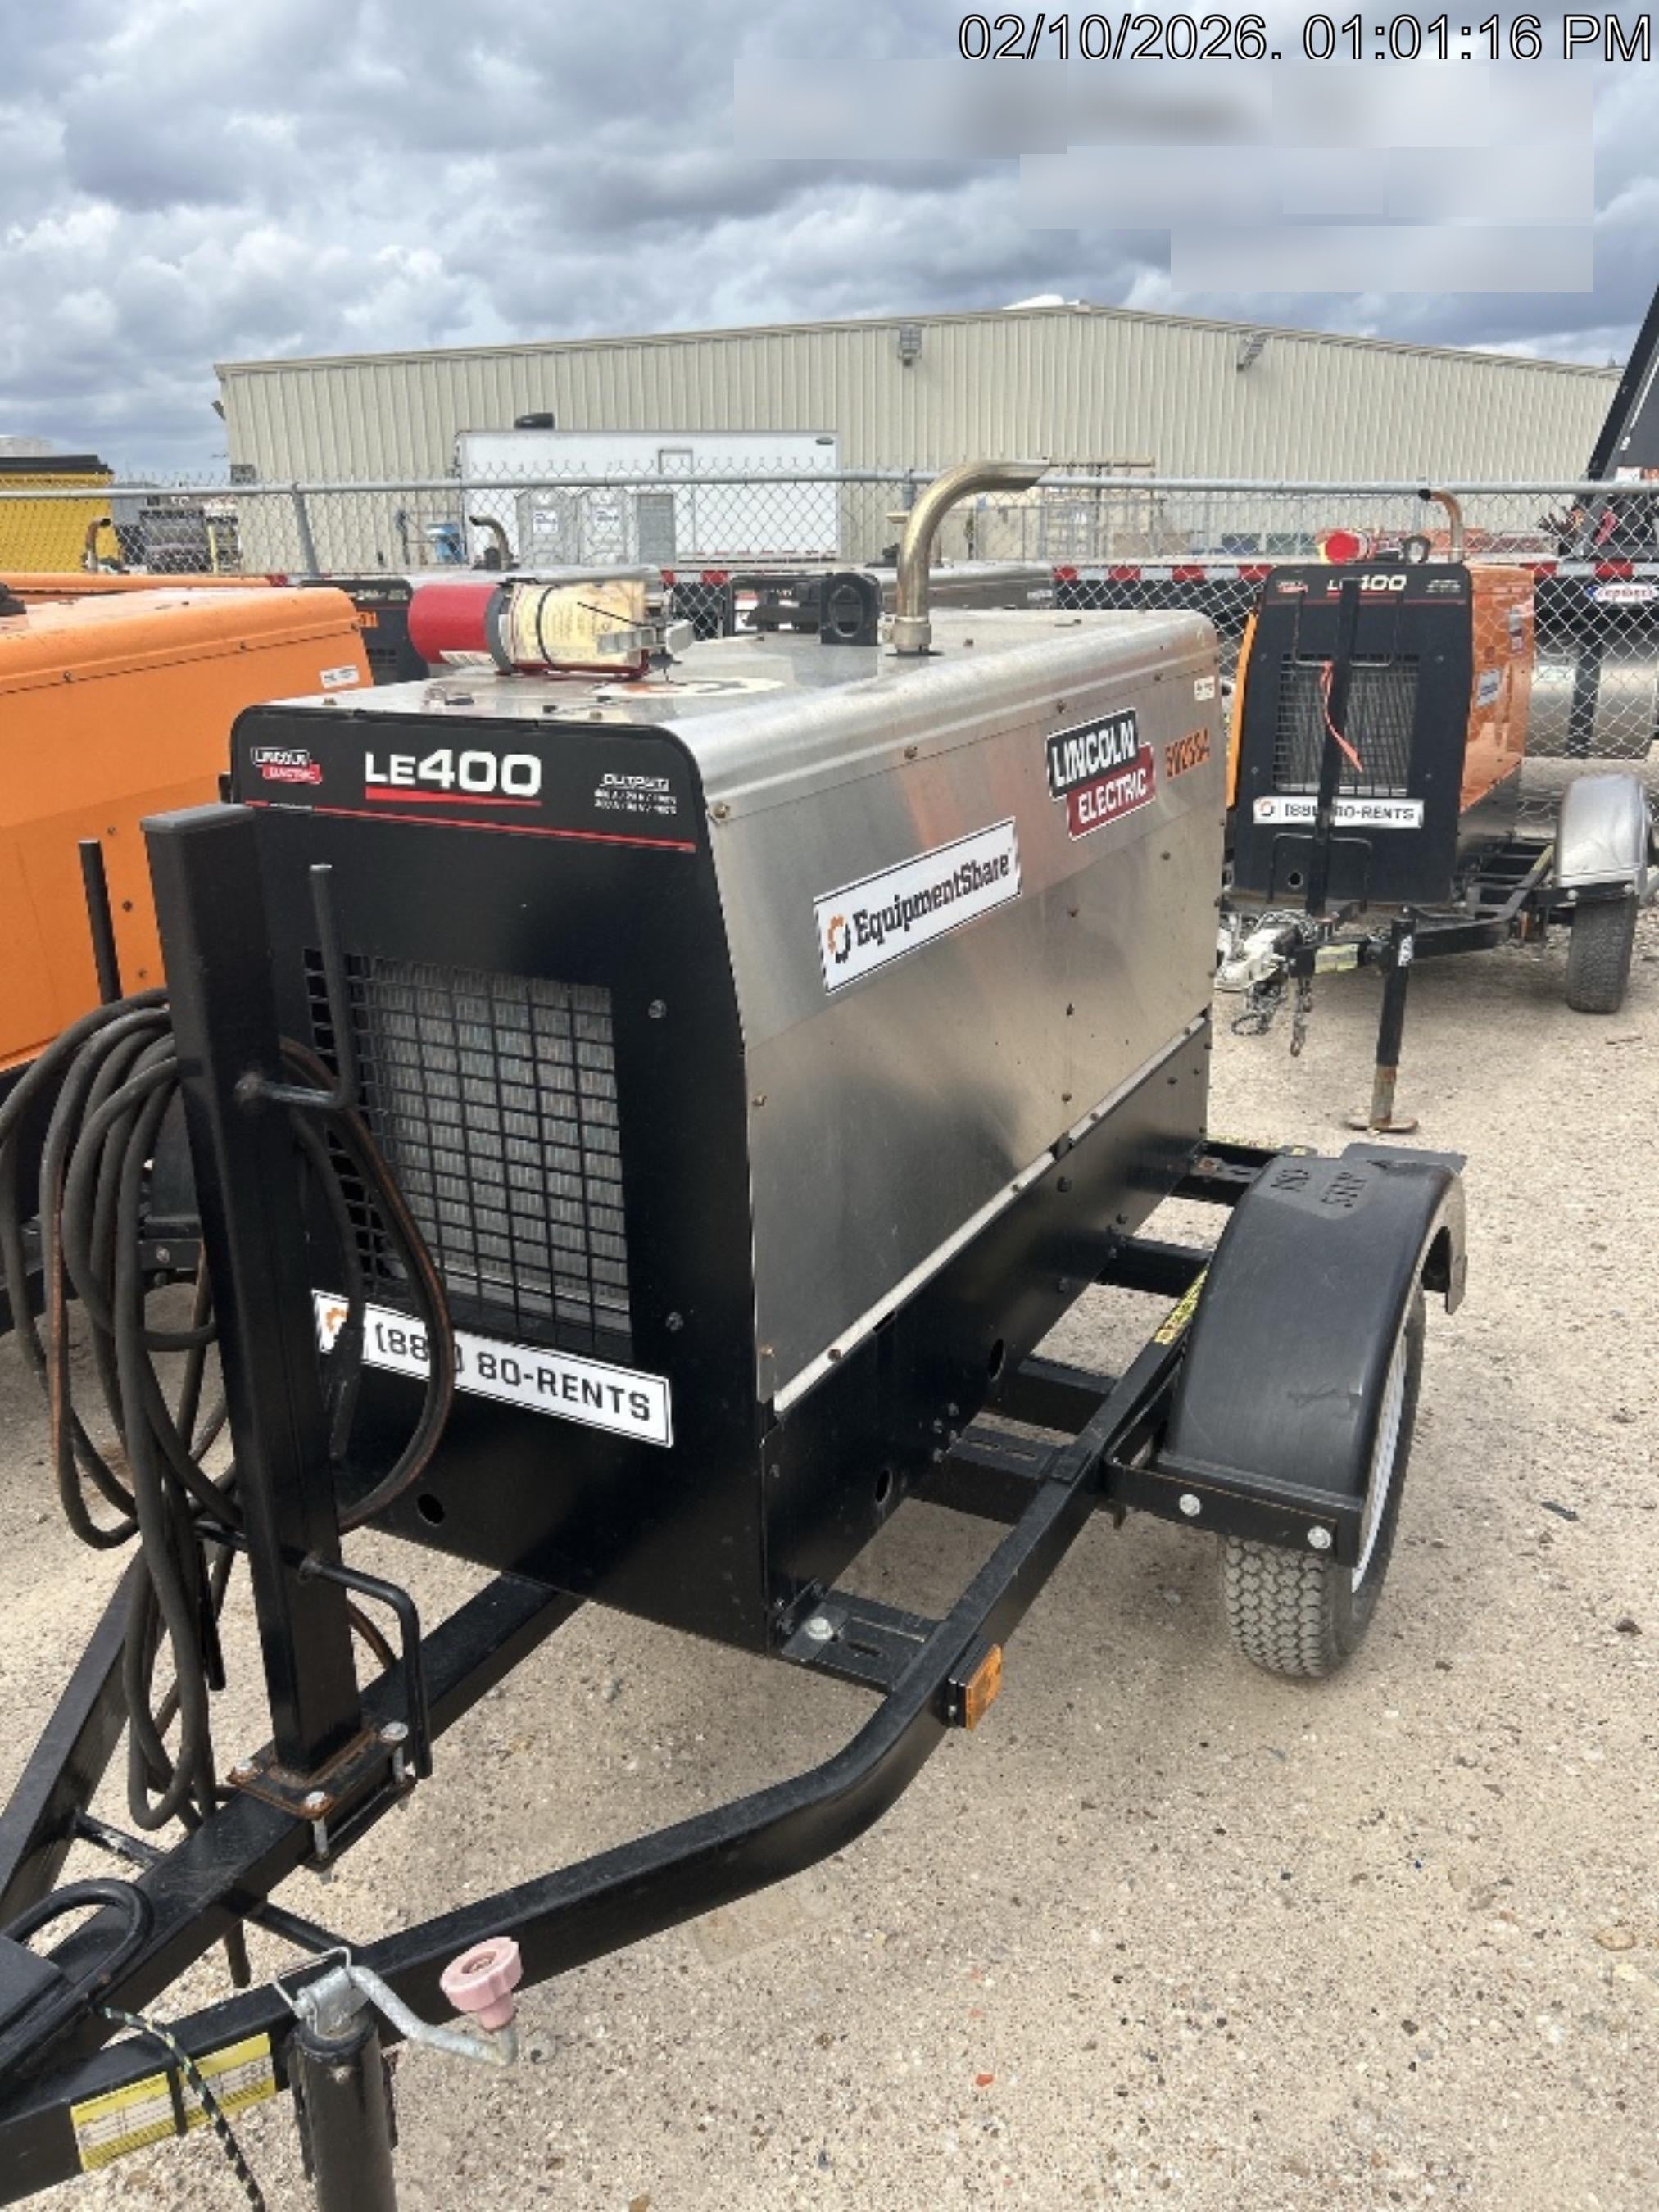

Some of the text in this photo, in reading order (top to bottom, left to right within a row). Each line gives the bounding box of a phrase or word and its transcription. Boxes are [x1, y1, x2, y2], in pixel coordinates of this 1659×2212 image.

[365, 749, 542, 796] LE400
[1052, 720, 1136, 787] LINCOLN
[1077, 768, 1147, 823] ELECTRIC
[853, 853, 1010, 946] EquipmentShare
[375, 1321, 650, 1422] (88) 80-RENTS
